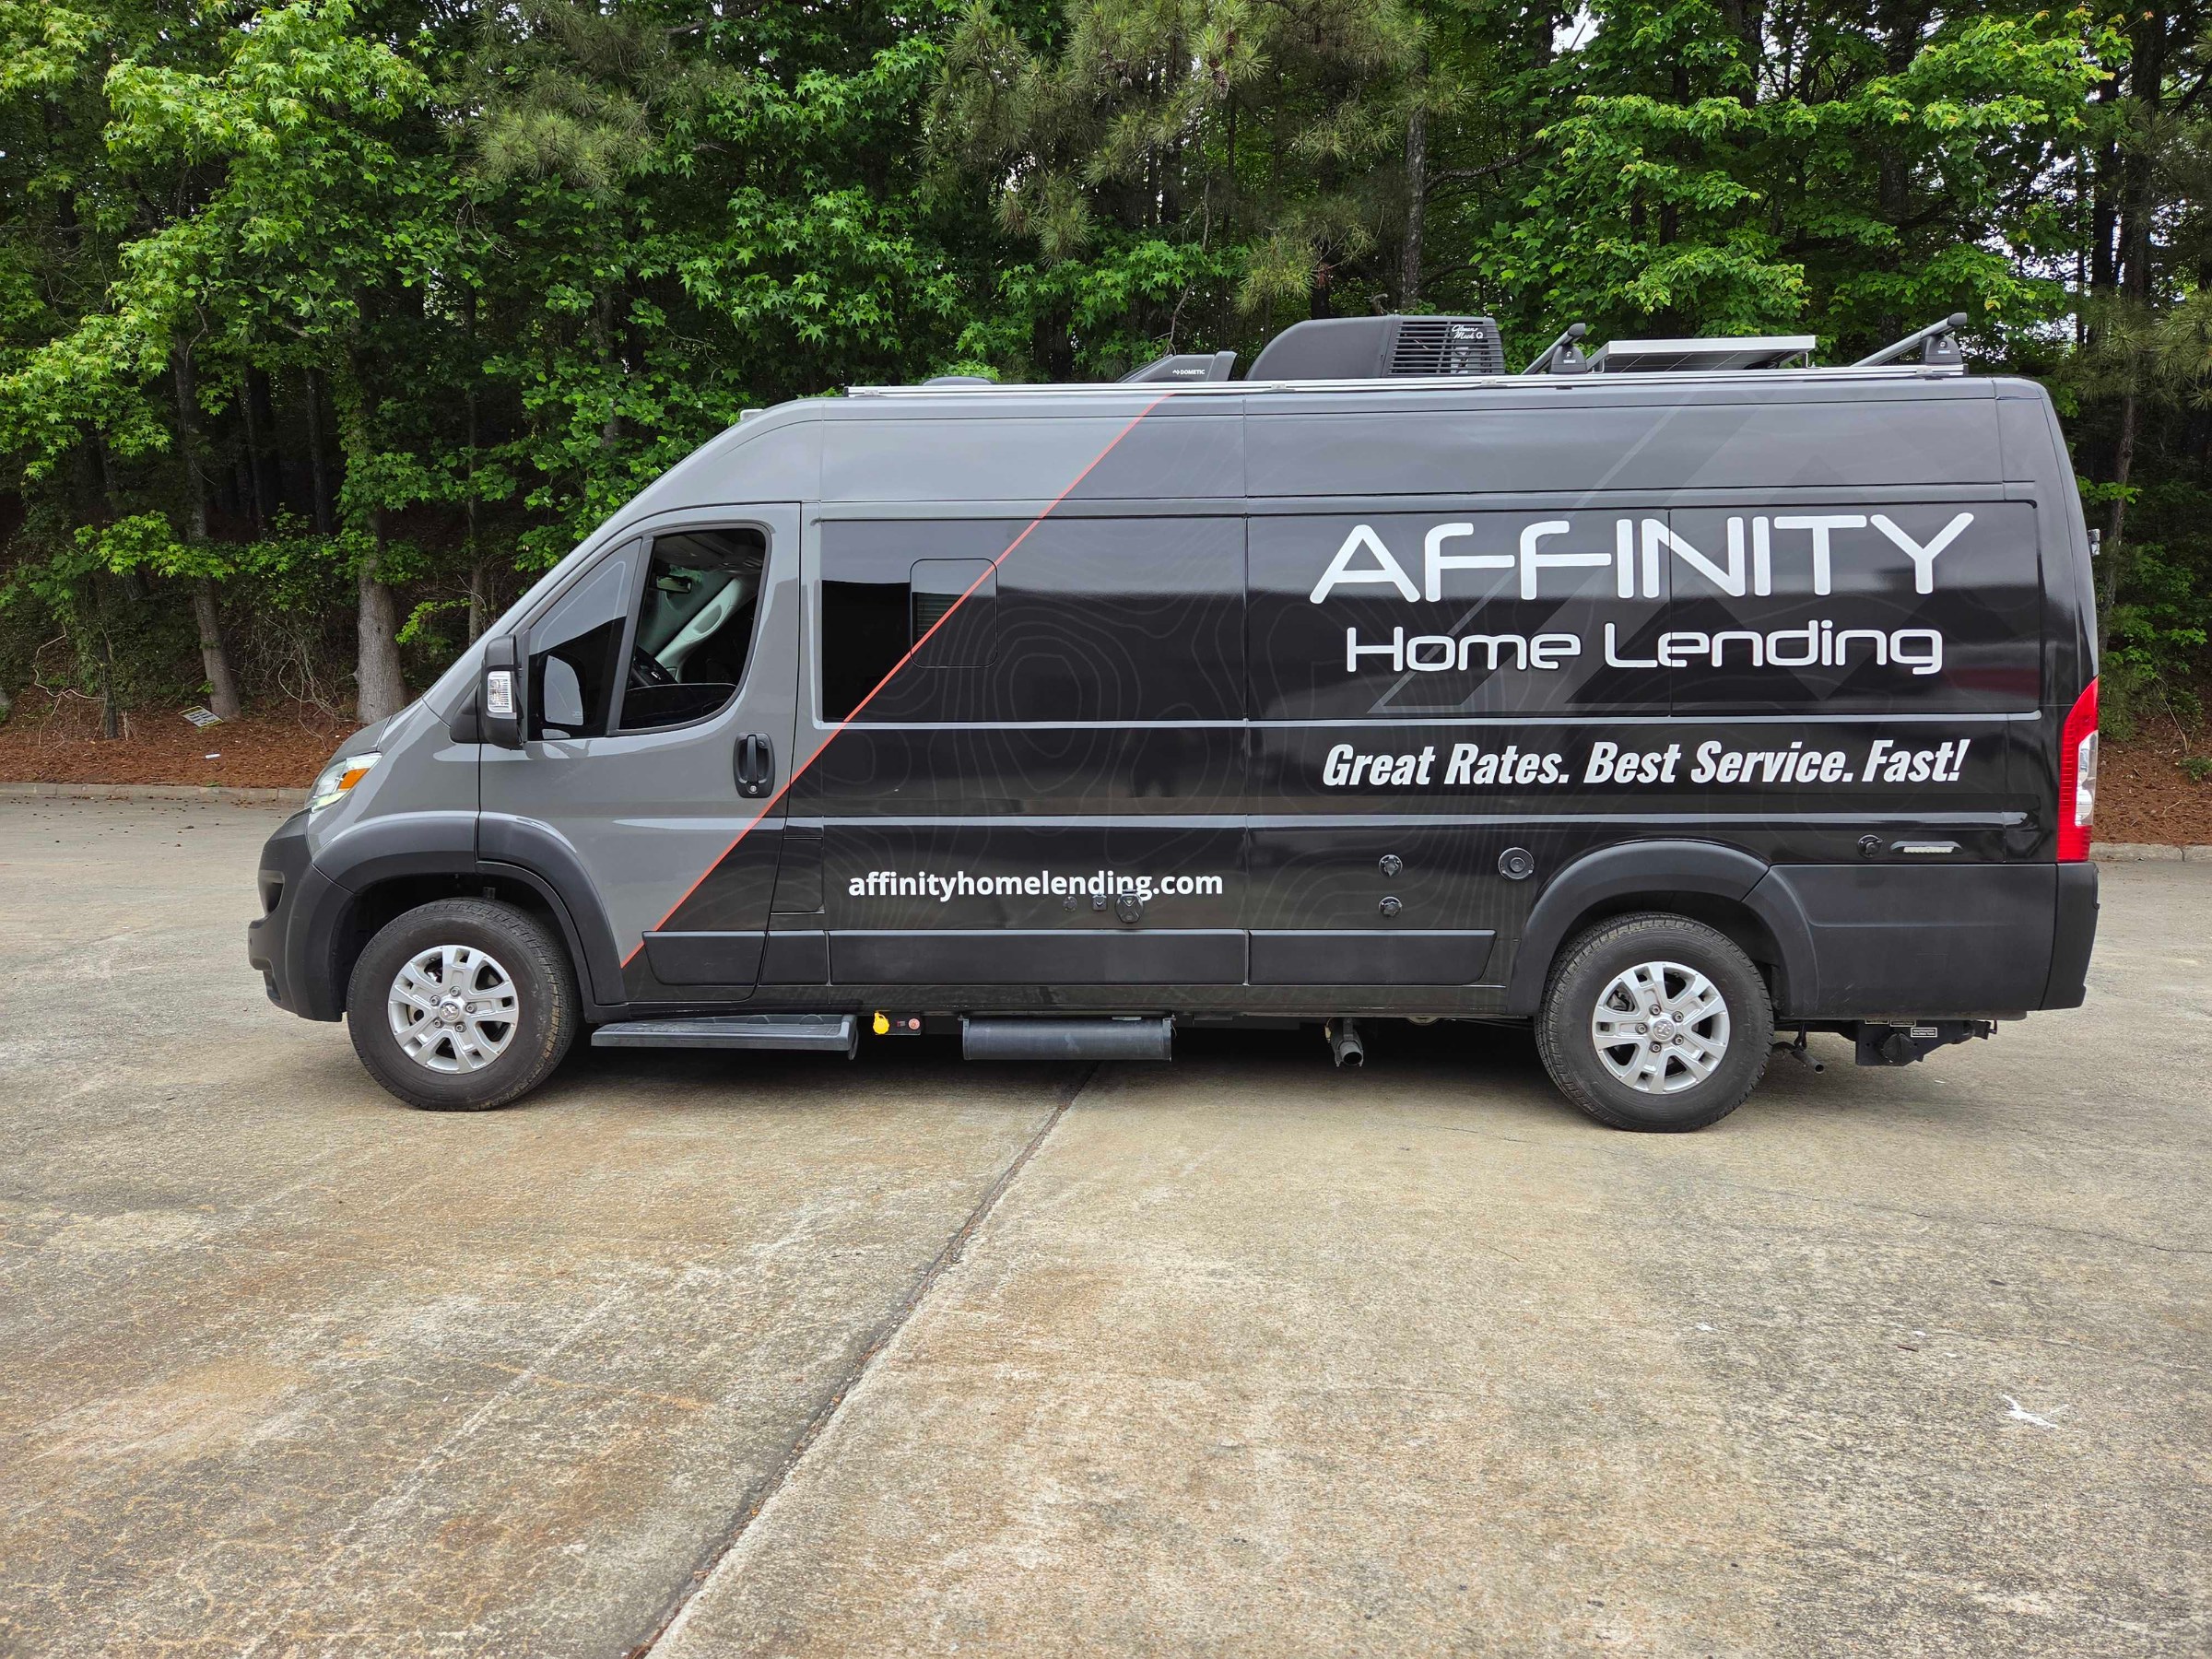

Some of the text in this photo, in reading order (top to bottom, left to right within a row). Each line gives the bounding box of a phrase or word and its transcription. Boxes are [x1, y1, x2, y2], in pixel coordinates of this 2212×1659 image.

[1309, 512, 1974, 604] AFFINITY
[1347, 619, 1943, 675] Home Lending
[1323, 738, 1971, 786] Great Rates. Best Service. Fast!
[848, 870, 1224, 902] affinityhomelending.com
